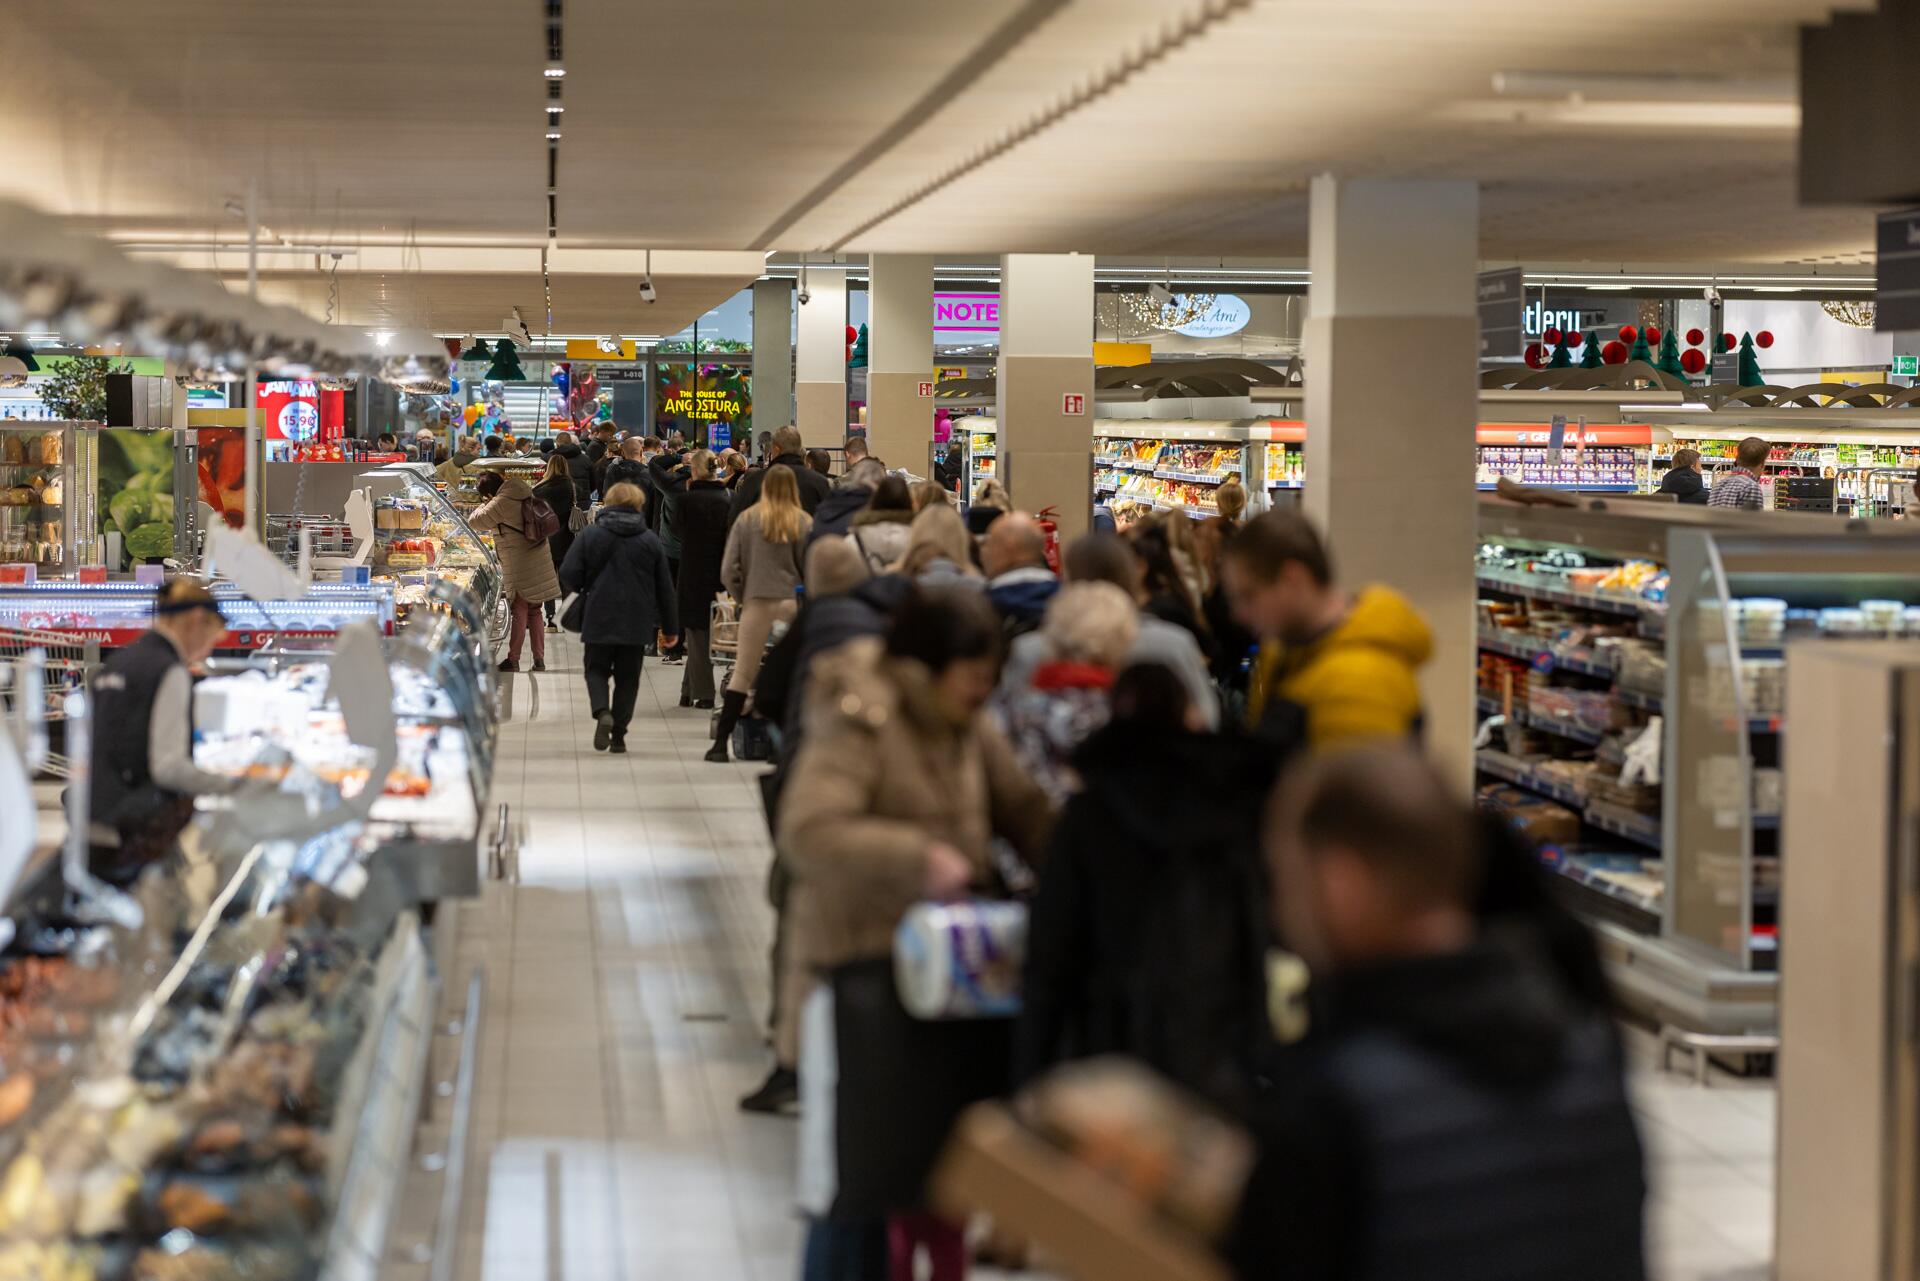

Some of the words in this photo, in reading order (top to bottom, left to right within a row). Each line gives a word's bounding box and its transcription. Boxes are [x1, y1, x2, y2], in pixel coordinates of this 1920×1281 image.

[934, 303, 999, 321] NOTE
[1522, 301, 1580, 336] tlery
[664, 398, 740, 415] ANGOSTURA
[1563, 432, 1598, 443] KANA
